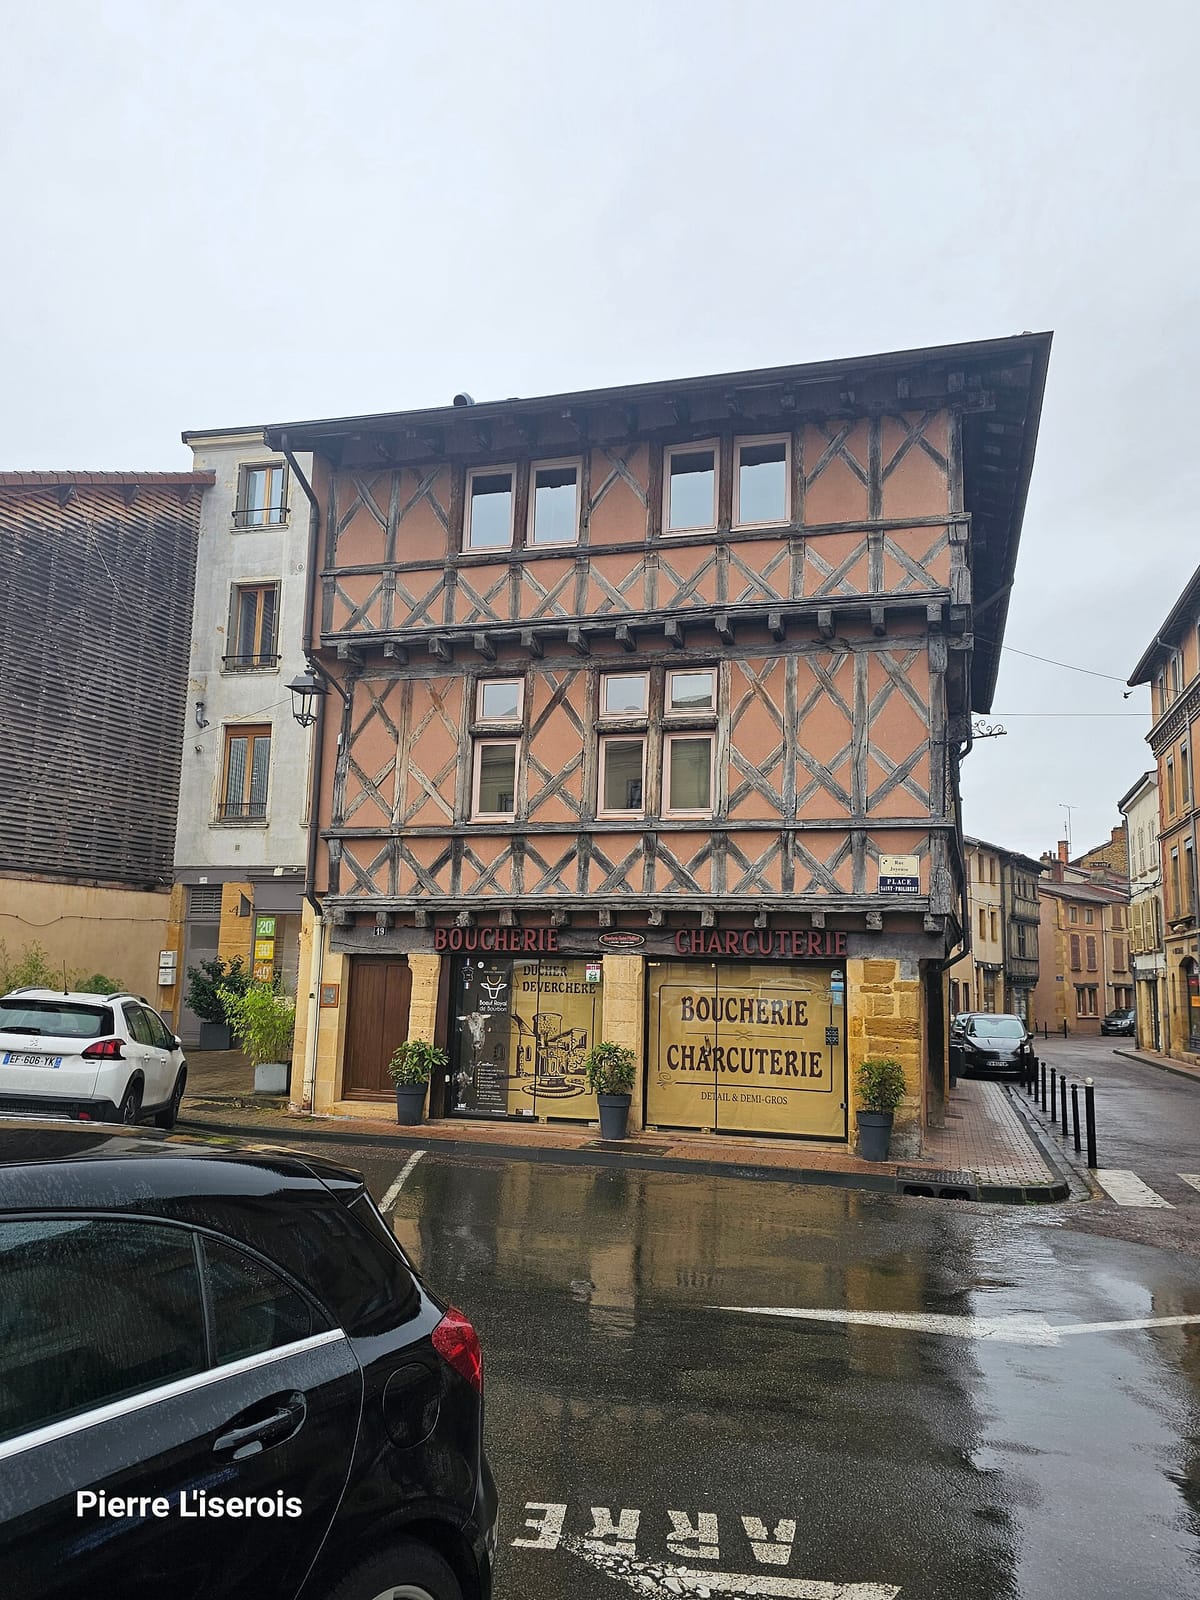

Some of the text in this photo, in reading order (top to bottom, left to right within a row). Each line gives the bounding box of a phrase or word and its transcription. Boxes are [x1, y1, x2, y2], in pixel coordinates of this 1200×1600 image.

[375, 927, 385, 936] 19
[434, 927, 560, 951] BOUCHERIE
[674, 929, 849, 957] CHARCUTERIE
[523, 965, 568, 977] DUCHER
[522, 981, 597, 995] DEVERCHERE
[680, 995, 809, 1027] BOUCHERIE
[9, 1054, 55, 1066] EF-606-YK
[666, 1044, 823, 1078] CHARCUTERIE
[701, 1091, 788, 1105] DETAIL & DEMI-GROS
[510, 1501, 797, 1565] ARRE
